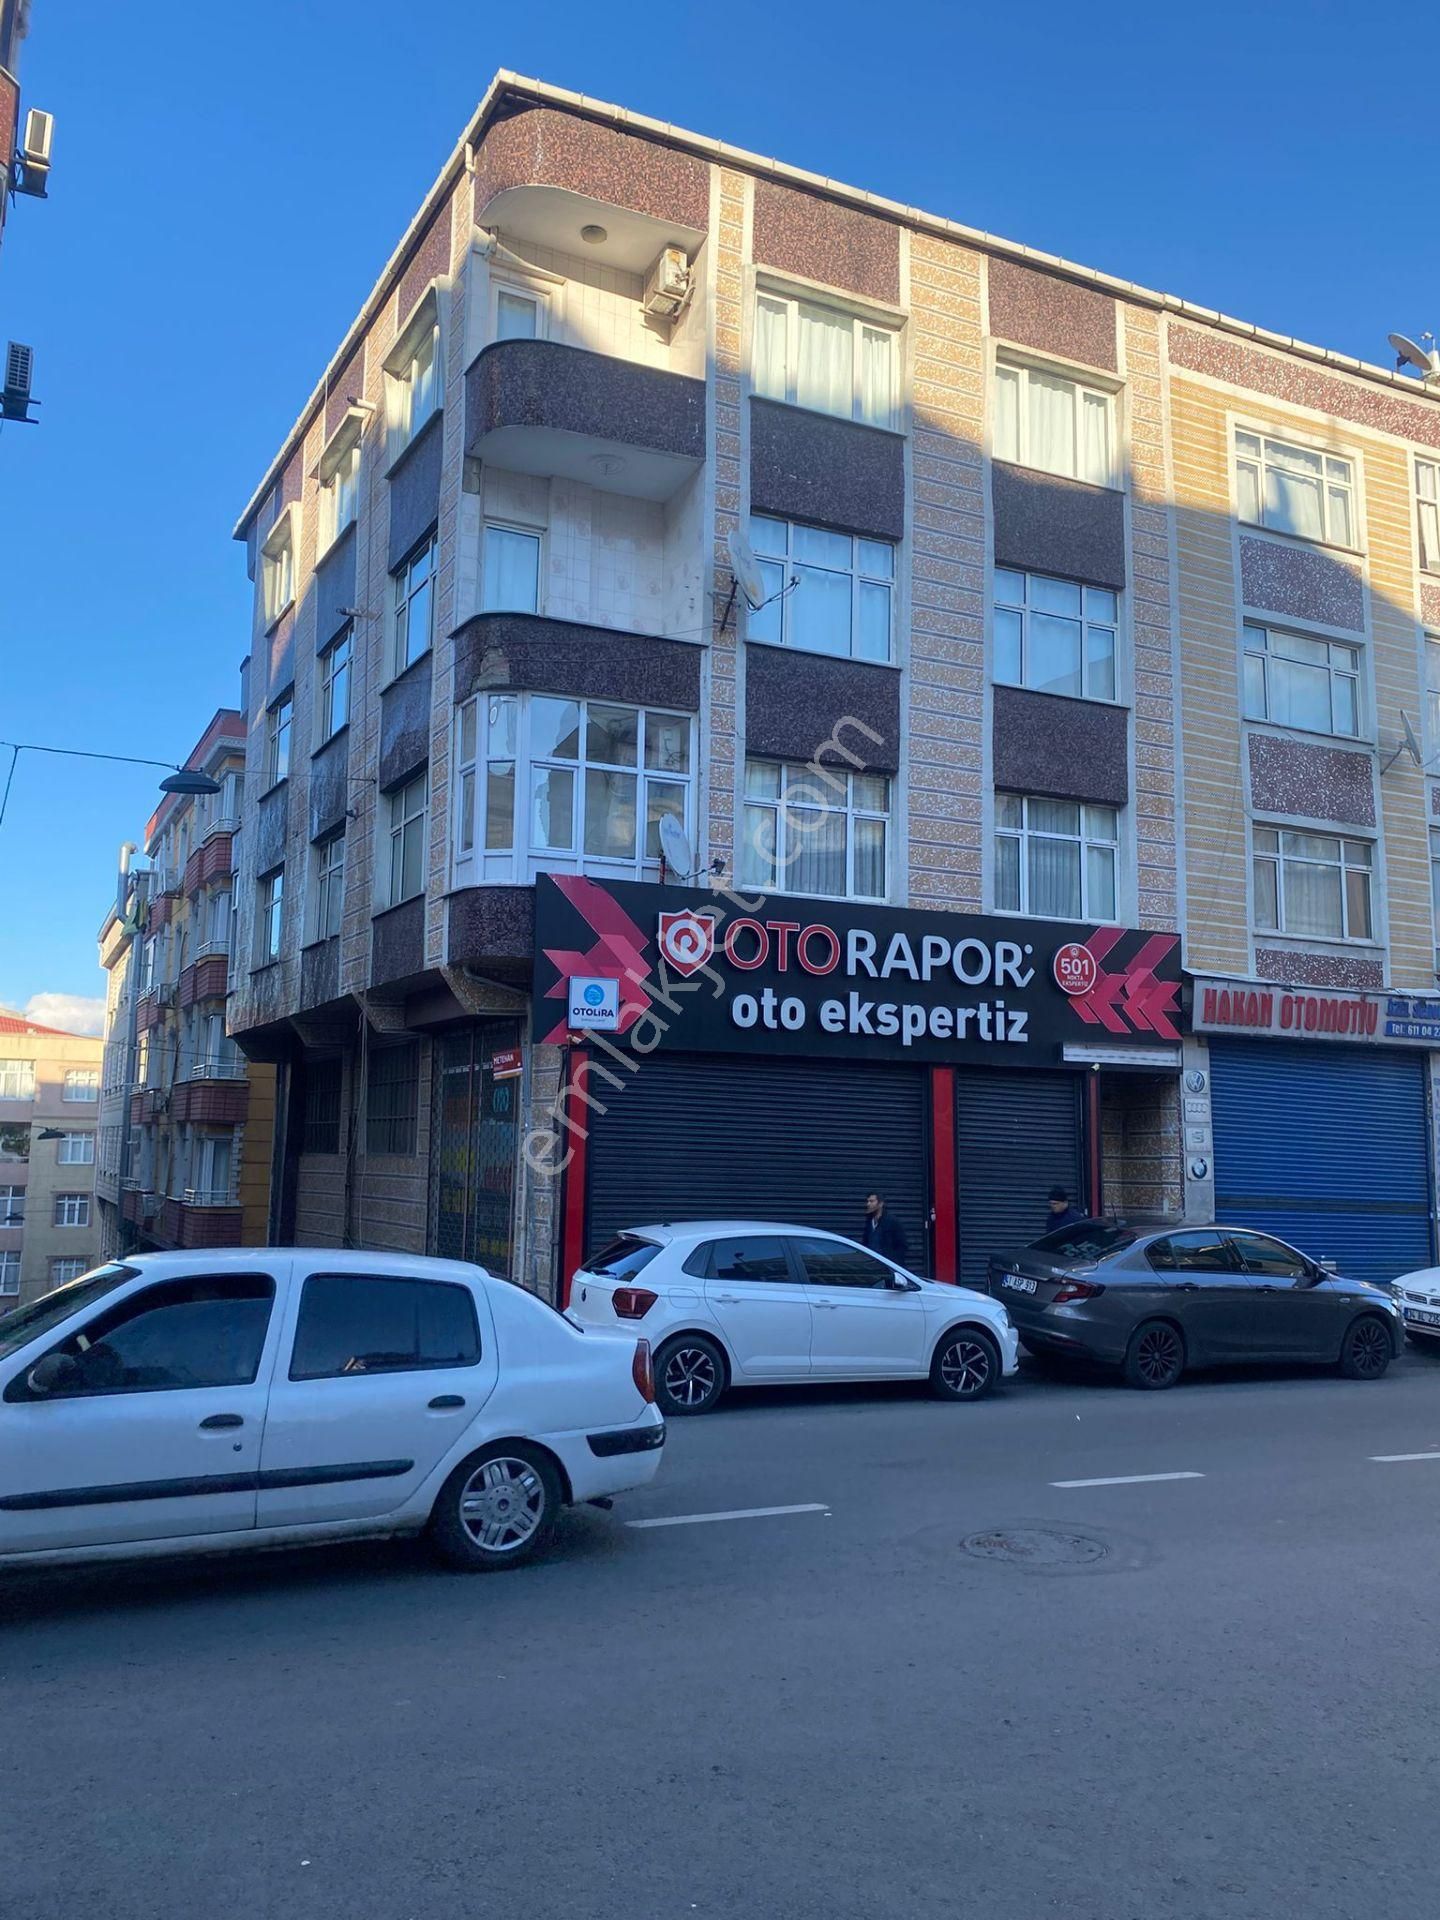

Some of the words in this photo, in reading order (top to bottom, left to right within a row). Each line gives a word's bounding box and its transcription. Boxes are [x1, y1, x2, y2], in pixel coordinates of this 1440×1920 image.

[1060, 958, 1089, 975] 501
[732, 987, 806, 1030] oto
[819, 991, 1029, 1046] ekspertiz
[1202, 988, 1273, 1028] HAKAN
